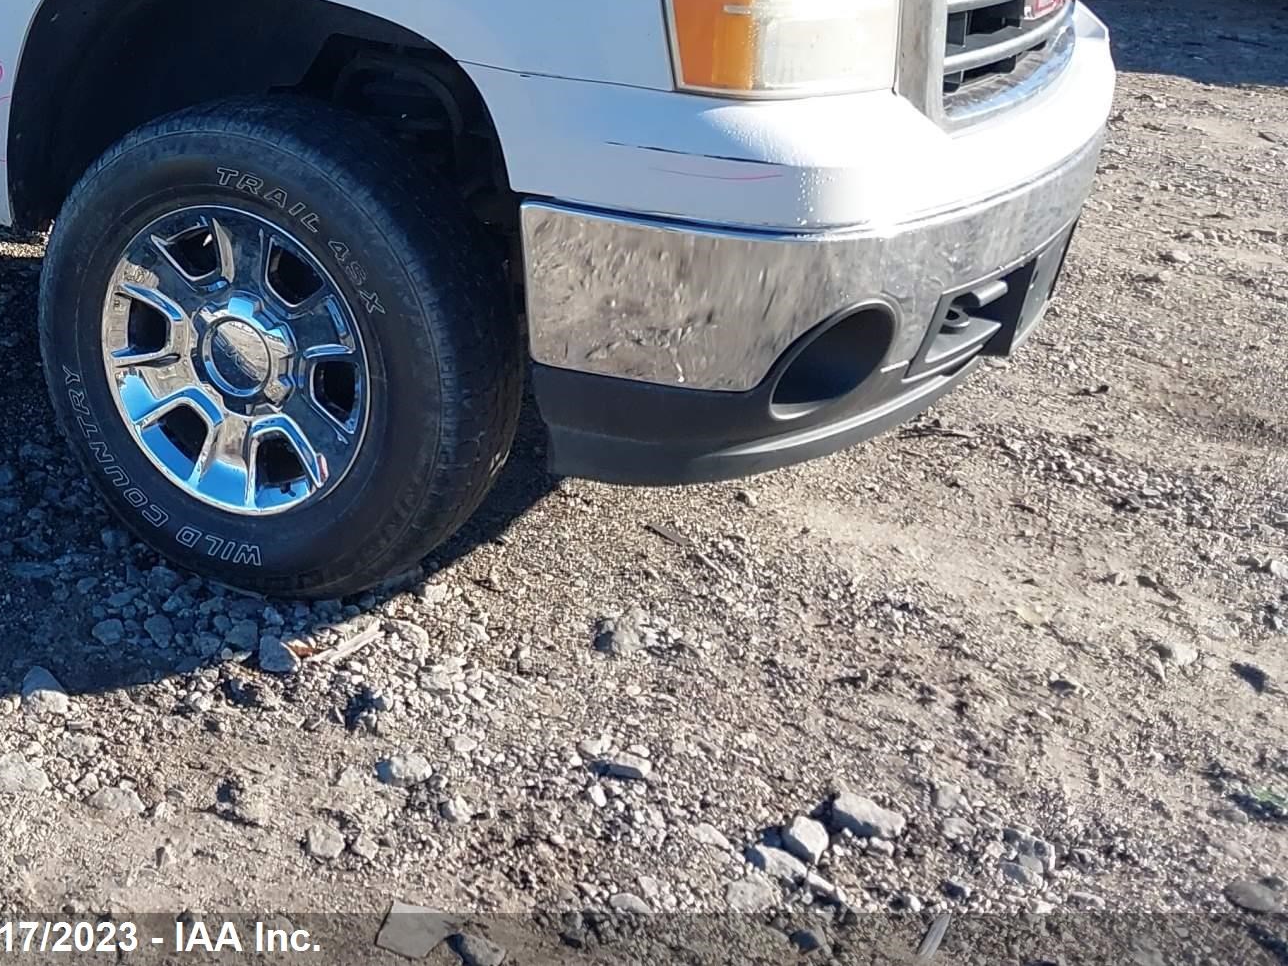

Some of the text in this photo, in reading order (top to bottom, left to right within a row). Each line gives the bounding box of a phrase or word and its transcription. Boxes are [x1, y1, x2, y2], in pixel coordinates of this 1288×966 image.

[216, 166, 387, 315] TRAIL 4SX
[62, 364, 262, 567] WILD COUNTRY
